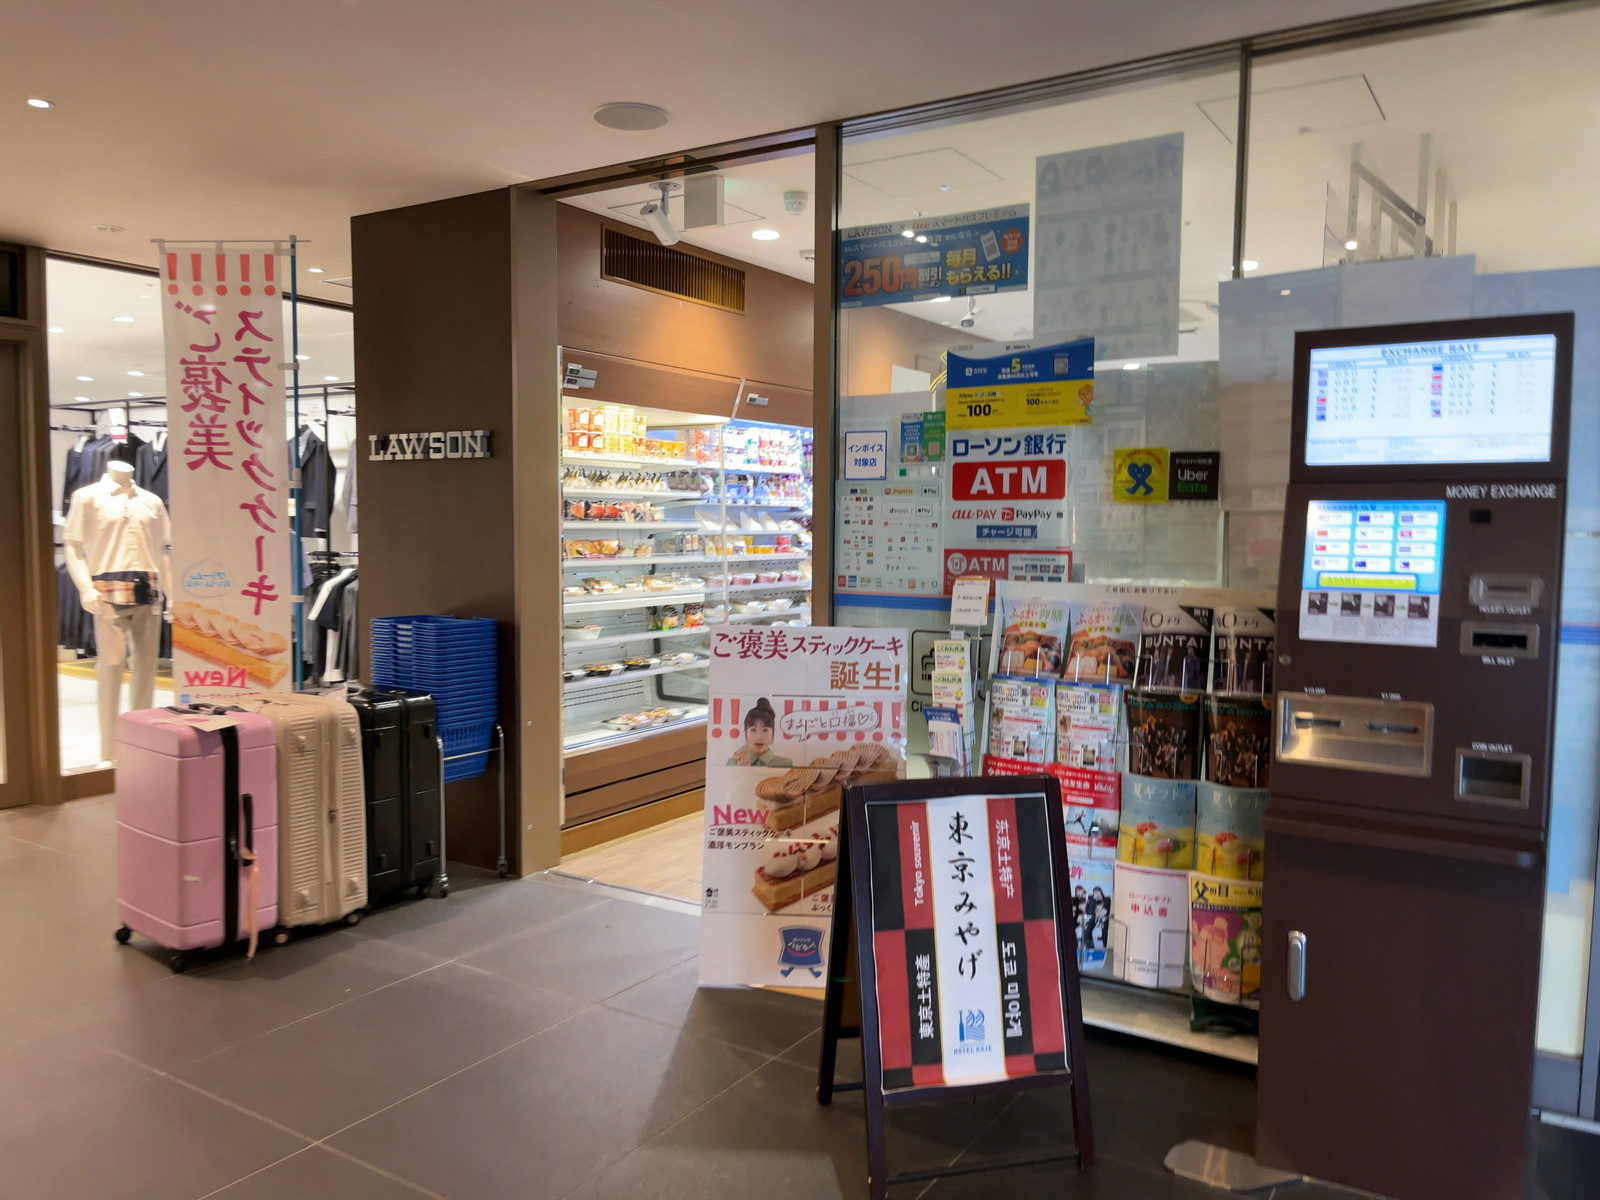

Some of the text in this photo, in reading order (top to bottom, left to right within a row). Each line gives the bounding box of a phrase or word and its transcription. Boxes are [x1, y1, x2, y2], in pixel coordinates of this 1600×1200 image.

[847, 224, 892, 239] LAWSON
[945, 248, 976, 267] 毎月
[1381, 344, 1445, 358] EXCHANGE
[1026, 398, 1040, 406] 100
[967, 404, 992, 417] 100
[368, 430, 490, 461] LAWSON
[848, 444, 884, 454] インボイス
[952, 434, 1066, 457] ローソン銀行
[853, 458, 878, 468] 対象店
[970, 466, 1047, 496] ATM
[1177, 468, 1208, 481] Uber
[1177, 482, 1208, 494] Eats
[1446, 484, 1557, 499] MONEY EXCHANGE
[976, 509, 998, 520] PAY
[1016, 509, 1052, 520] PayPay
[982, 528, 1032, 537] チャージ可能
[968, 557, 1005, 572] ATM
[713, 628, 904, 660] ご褒美スティックケーキ
[1144, 636, 1204, 649] BUNTAI
[830, 661, 900, 691] 誕生!
[713, 804, 772, 826] New
[910, 820, 924, 906] Tokyo souvenir
[995, 818, 1016, 899] 东京土特产
[948, 811, 983, 981] 東京みやげ
[1002, 940, 1022, 1038] 도쿄 미야게
